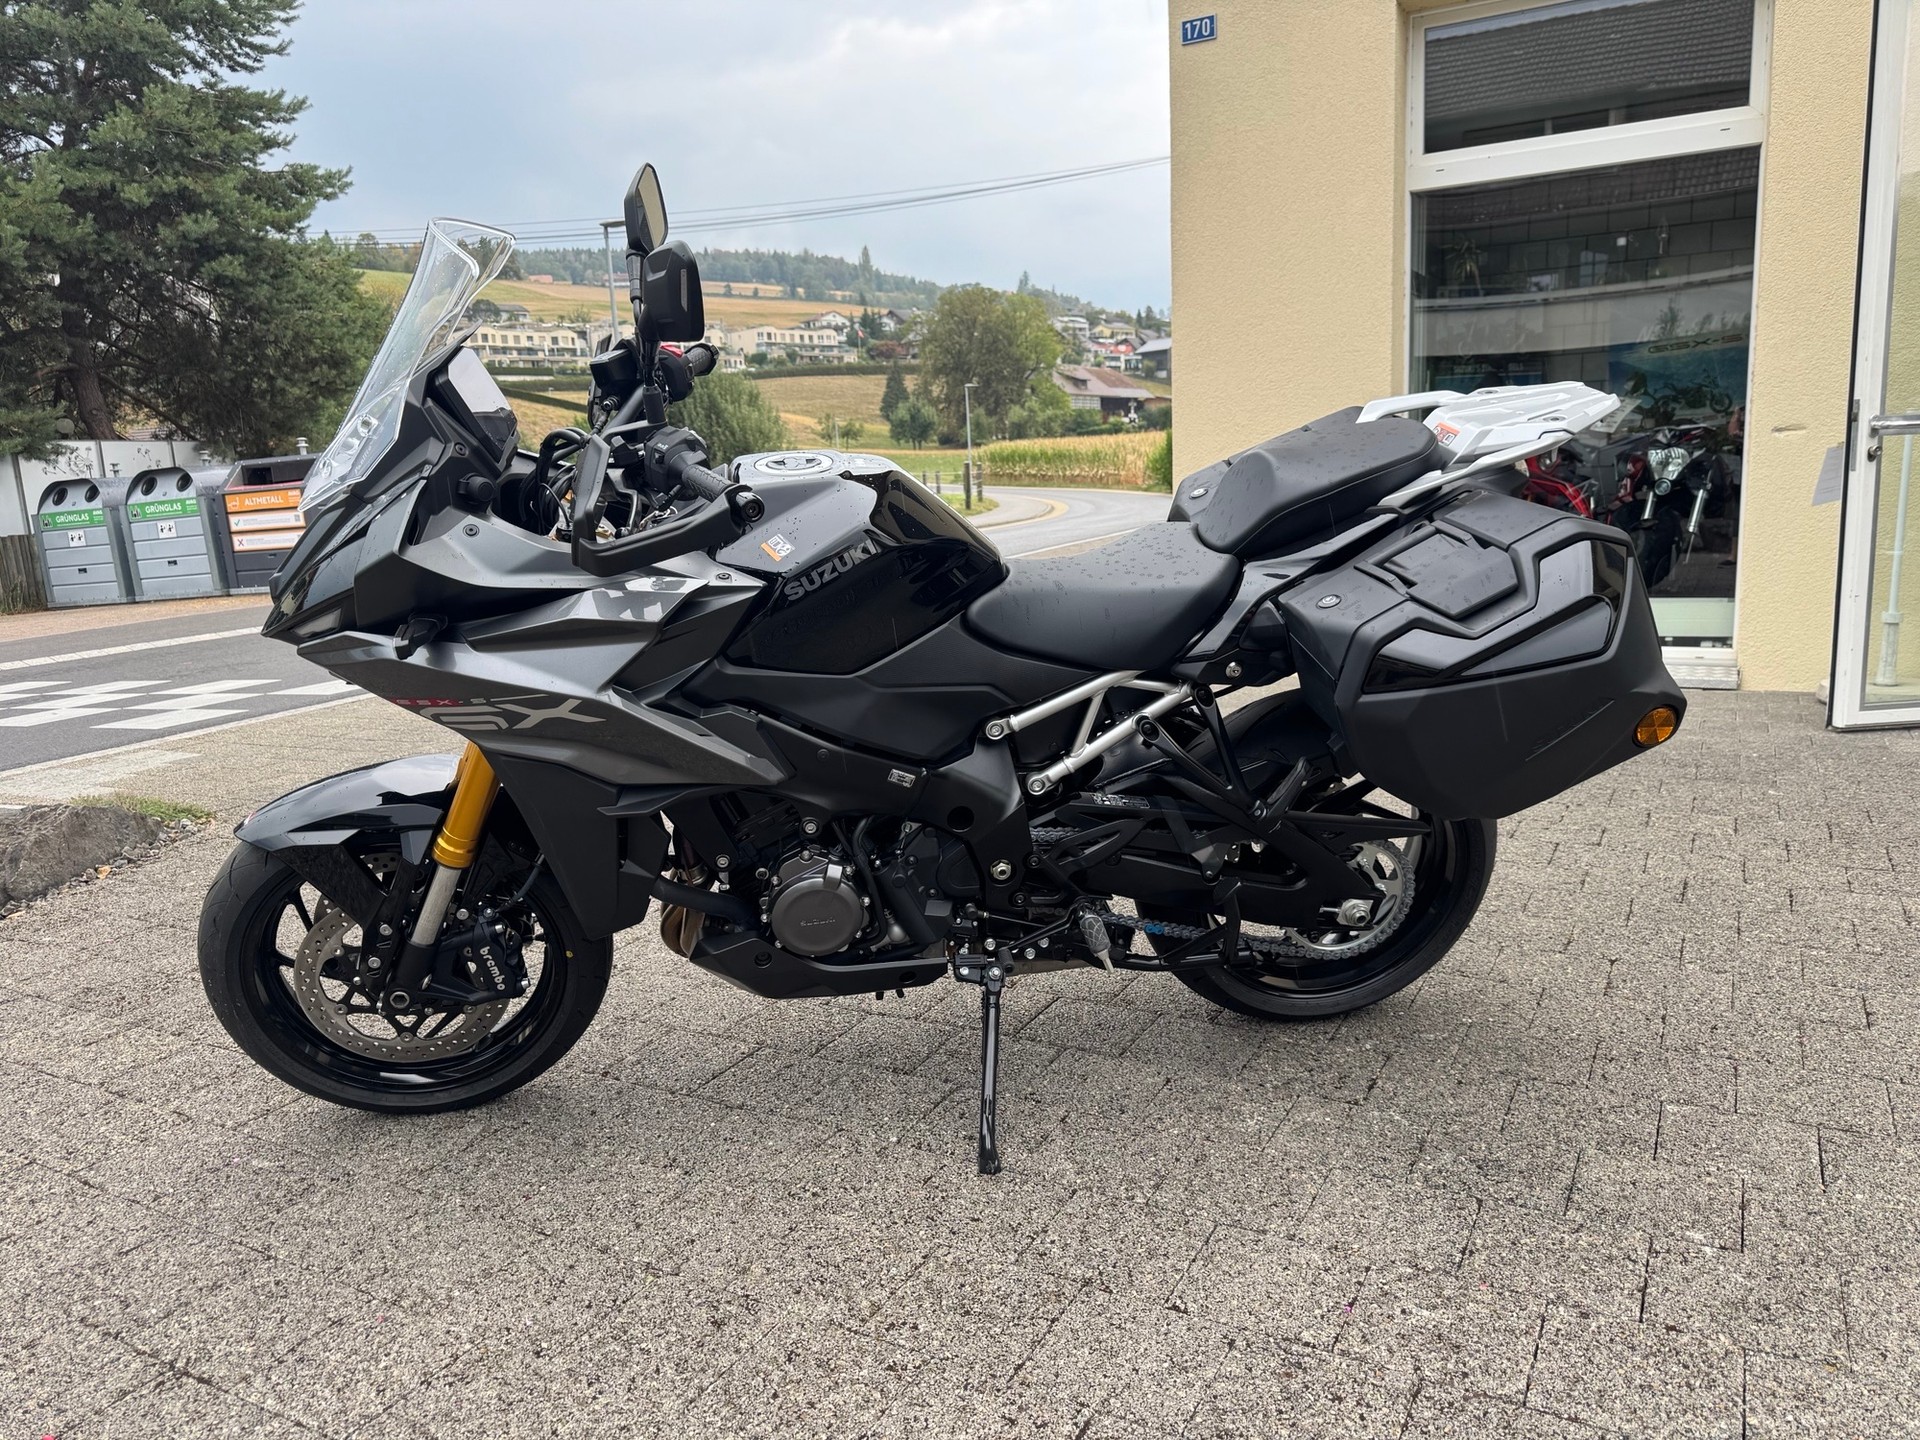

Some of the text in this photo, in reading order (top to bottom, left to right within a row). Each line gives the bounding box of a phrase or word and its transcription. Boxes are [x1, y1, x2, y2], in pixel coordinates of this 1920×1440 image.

[1184, 18, 1210, 39] 170
[1648, 333, 1743, 354] GSX-S
[145, 502, 182, 514] GRÜNGLAS
[244, 495, 284, 506] ALTMETALL
[55, 512, 90, 523] GRÜNGLAS
[784, 540, 878, 601] SUZUKI
[479, 946, 506, 990] brembo
